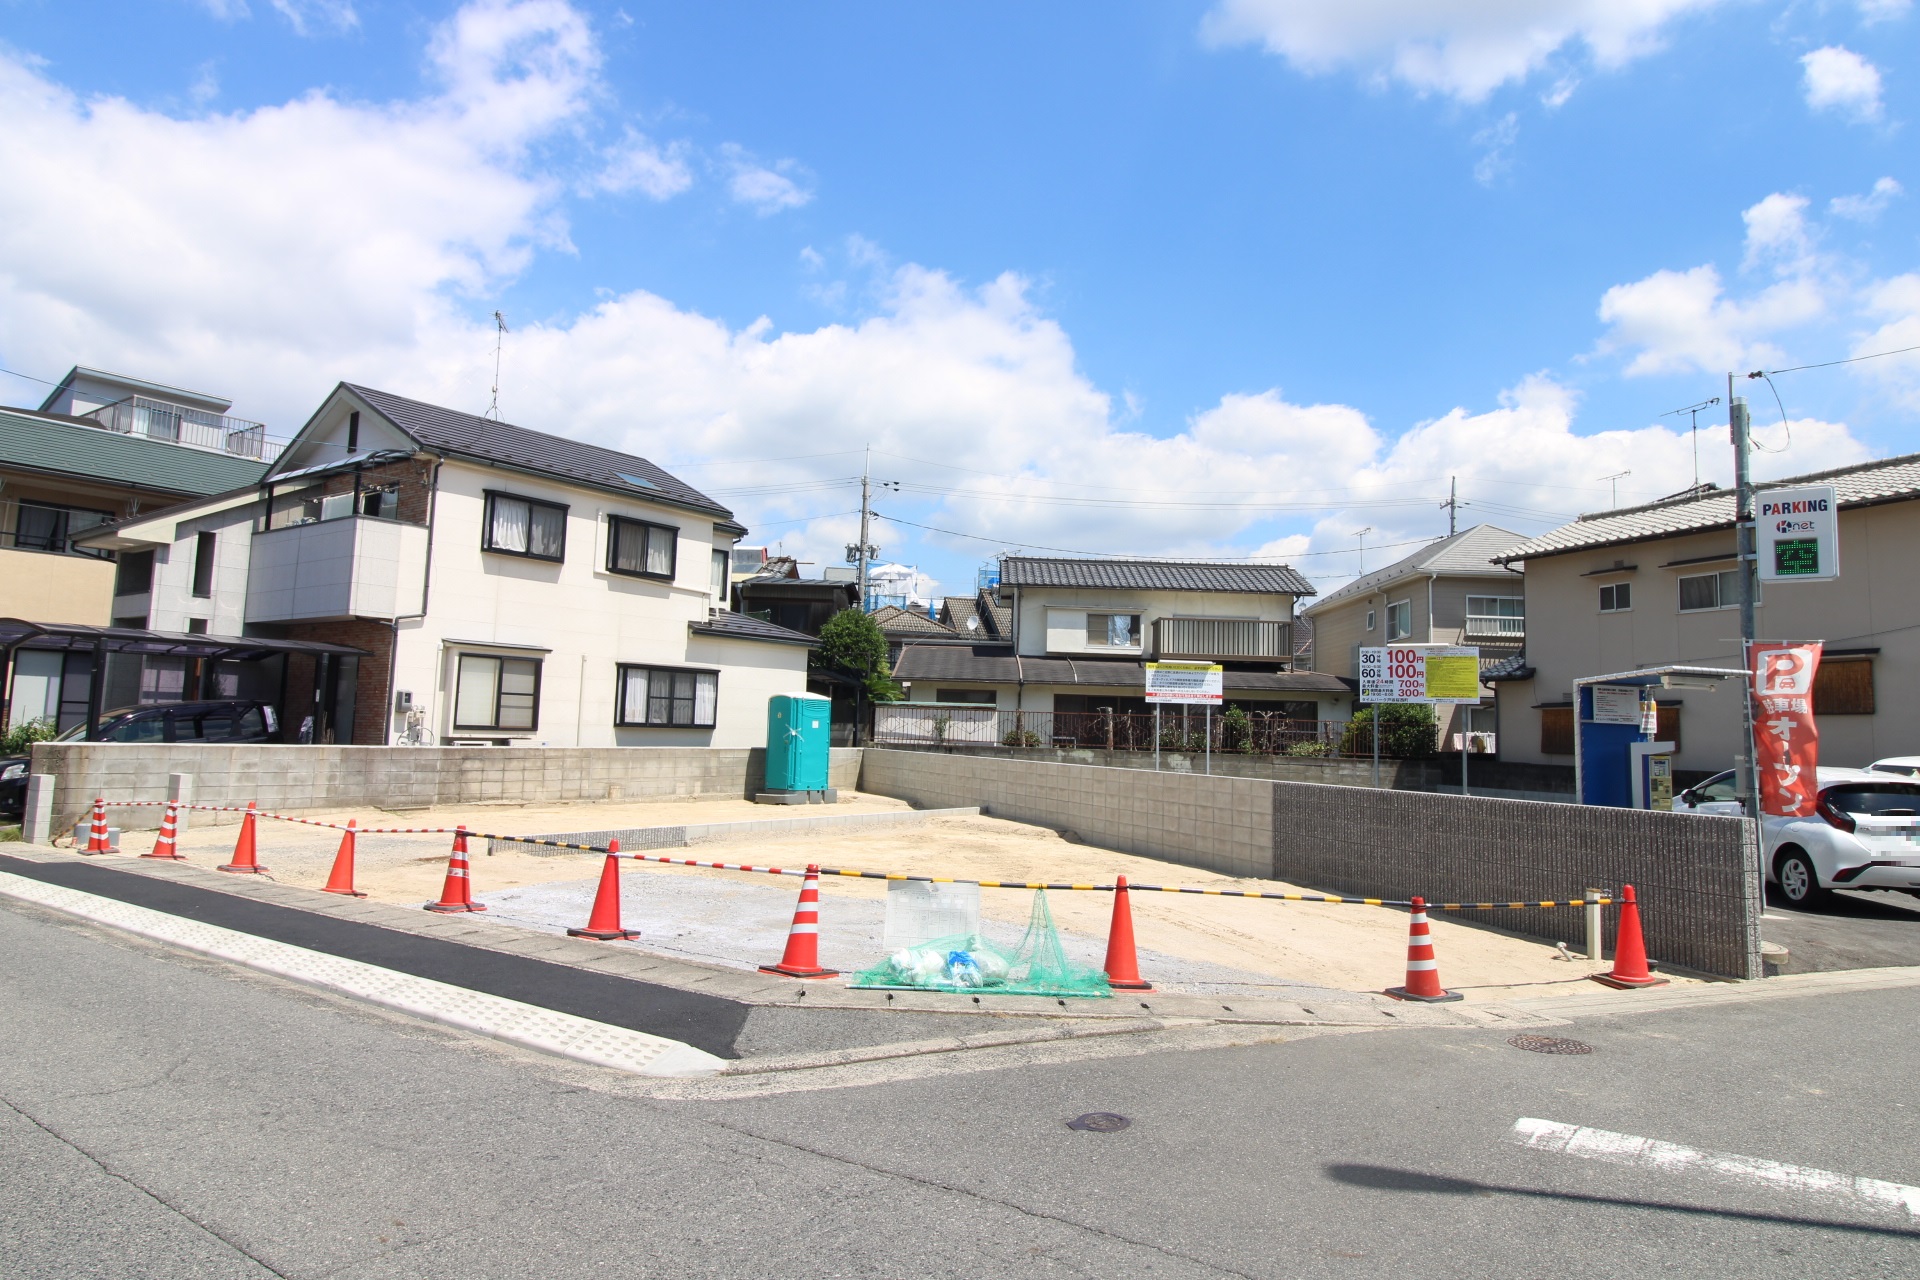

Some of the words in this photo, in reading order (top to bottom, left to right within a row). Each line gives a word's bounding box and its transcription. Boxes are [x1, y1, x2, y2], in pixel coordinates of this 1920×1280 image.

[1763, 499, 1828, 516] PARKING
[1776, 540, 1818, 575] 空
[1362, 654, 1375, 663] 30
[1387, 649, 1424, 663] 100円
[1362, 668, 1375, 678] 60
[1387, 664, 1424, 678] 100円
[1765, 654, 1804, 691] P
[1398, 680, 1424, 688] 700円
[1398, 689, 1424, 697] 300円
[1762, 698, 1807, 714] 駐車場
[1766, 716, 1802, 813] オープン
